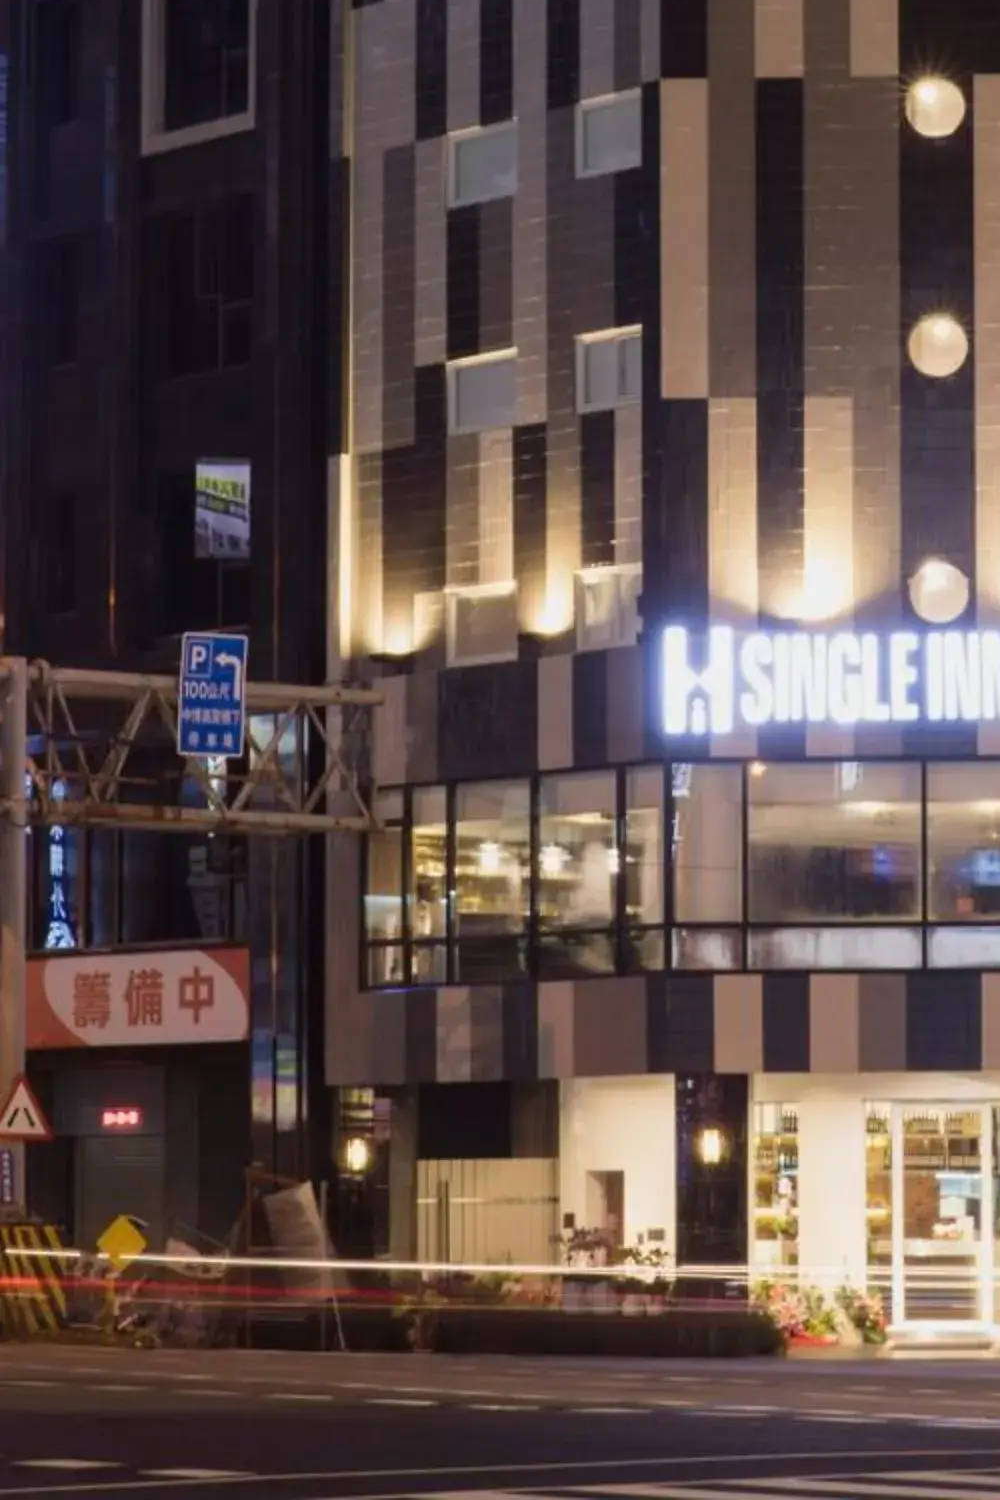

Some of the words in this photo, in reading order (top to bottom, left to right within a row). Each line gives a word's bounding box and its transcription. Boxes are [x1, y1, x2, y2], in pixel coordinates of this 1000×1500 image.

[191, 645, 206, 671] P
[740, 632, 919, 726] SINGLE
[73, 966, 214, 1029] 籌備中
